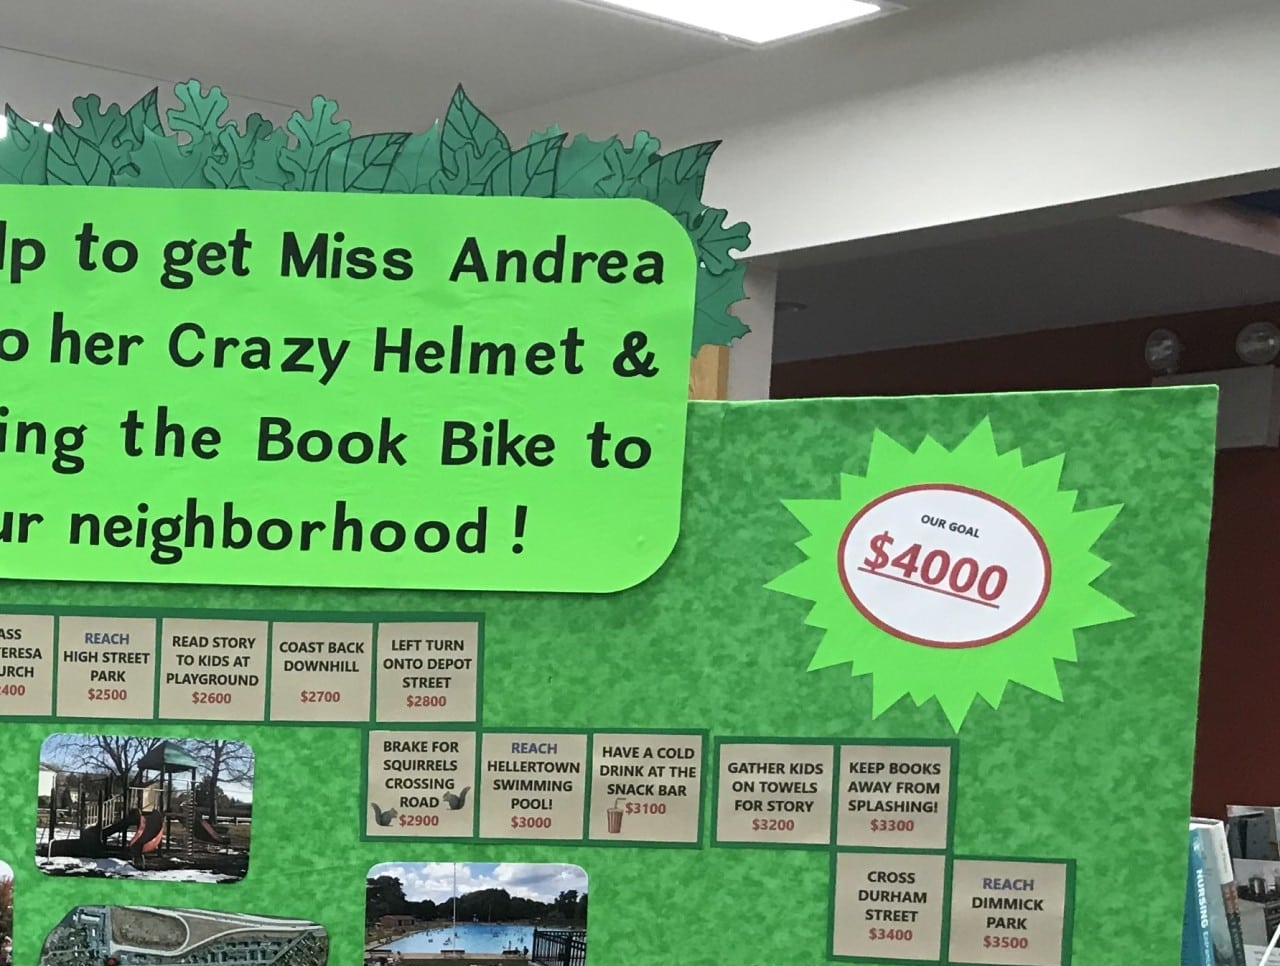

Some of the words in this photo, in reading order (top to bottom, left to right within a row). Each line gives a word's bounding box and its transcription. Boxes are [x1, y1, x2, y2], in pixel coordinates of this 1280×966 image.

[75, 223, 138, 273] to
[161, 229, 252, 289] get
[281, 232, 413, 280] Miss
[449, 235, 663, 285] Andrea
[51, 312, 144, 365] her
[169, 323, 350, 385] Crazy
[374, 325, 584, 376] Helmet
[613, 331, 659, 377] &
[120, 406, 221, 459] the
[258, 417, 407, 466] Book
[442, 419, 555, 467] Bike
[587, 422, 651, 469] to
[70, 498, 487, 564] neighborhood
[512, 505, 527, 554] !
[921, 515, 946, 528] OUR
[949, 523, 979, 538] GOAL
[863, 530, 1008, 601] $4000
[85, 633, 129, 644] REACH
[280, 642, 324, 653] COAST
[329, 642, 364, 653] BACK
[64, 651, 98, 662] HIGH
[103, 652, 150, 664] STREET
[285, 661, 359, 672] DOWNHILL
[91, 670, 125, 682] PARK
[88, 688, 127, 700] $2500
[301, 690, 340, 702] $2700
[512, 743, 557, 754] REACH
[488, 761, 580, 773] HELLERTOWN
[493, 780, 572, 791] SWIMMING
[512, 798, 552, 809] POOL!
[512, 816, 551, 828] $3000
[983, 878, 1034, 891] REACH
[972, 897, 1043, 911] DIMMICK
[1196, 868, 1209, 929] NURSING
[987, 917, 1027, 929] PARK
[984, 936, 1028, 948] $3500
